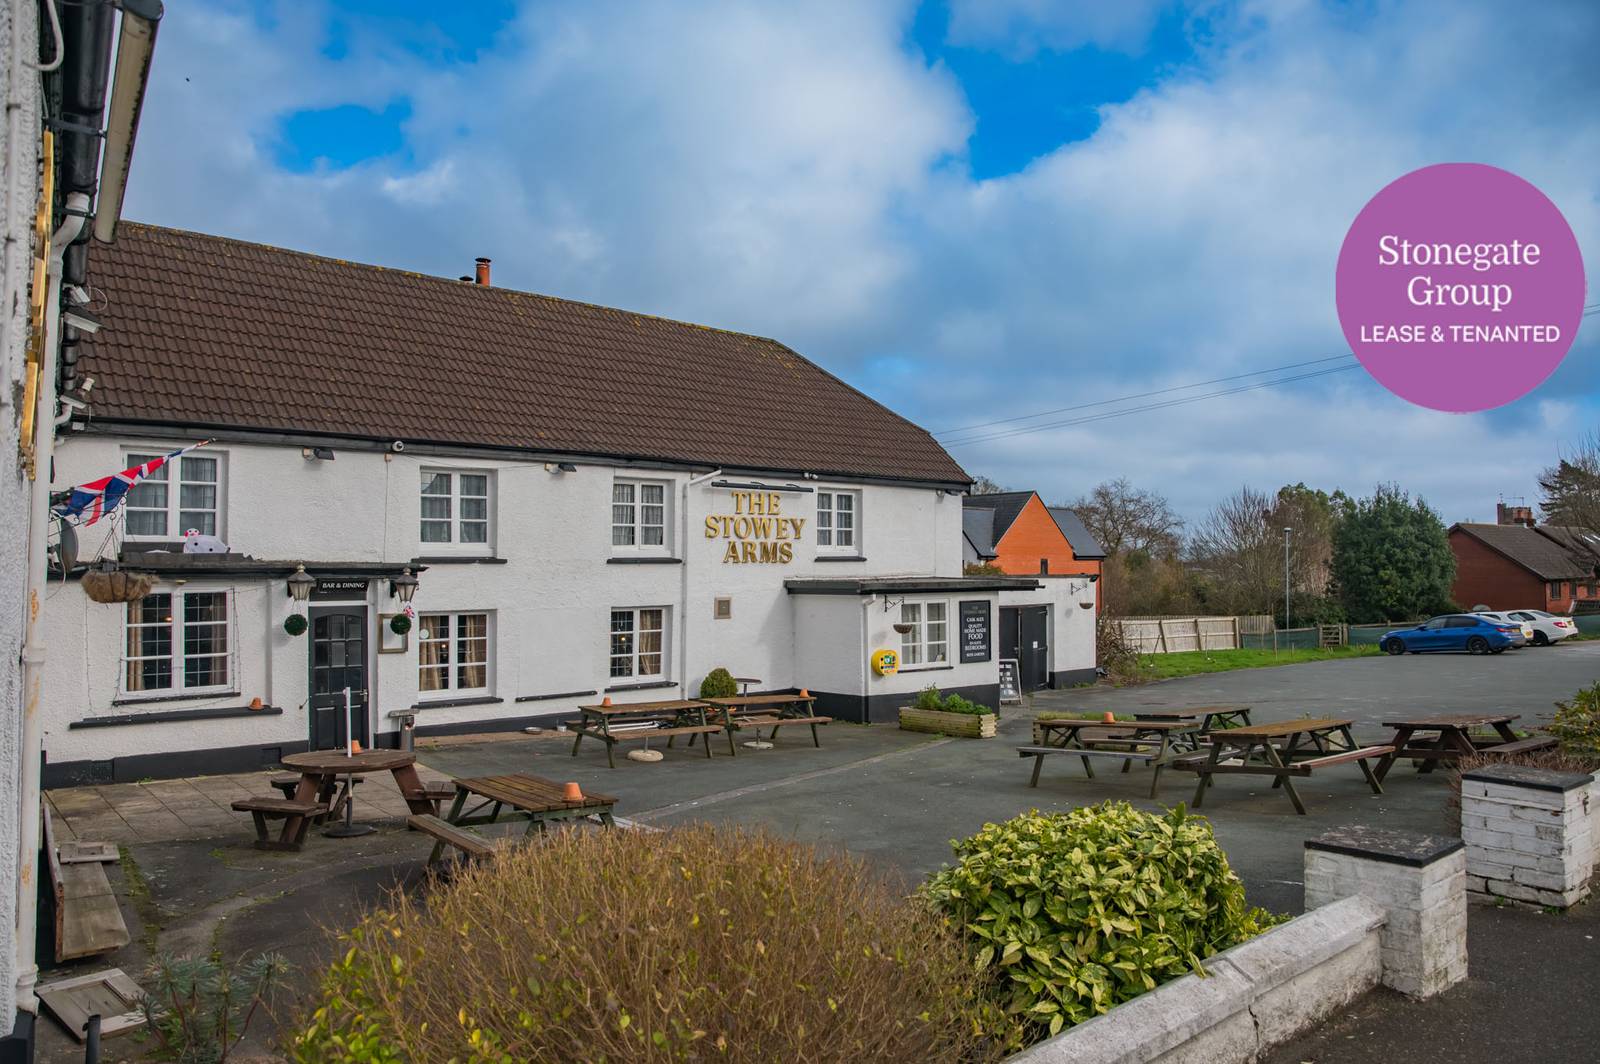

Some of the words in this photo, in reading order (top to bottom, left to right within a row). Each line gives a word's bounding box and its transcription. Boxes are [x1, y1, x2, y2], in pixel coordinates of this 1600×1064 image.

[731, 490, 781, 515] THE
[704, 515, 807, 540] STOWEY
[722, 540, 793, 564] ARMS
[968, 632, 984, 640] FOOD
